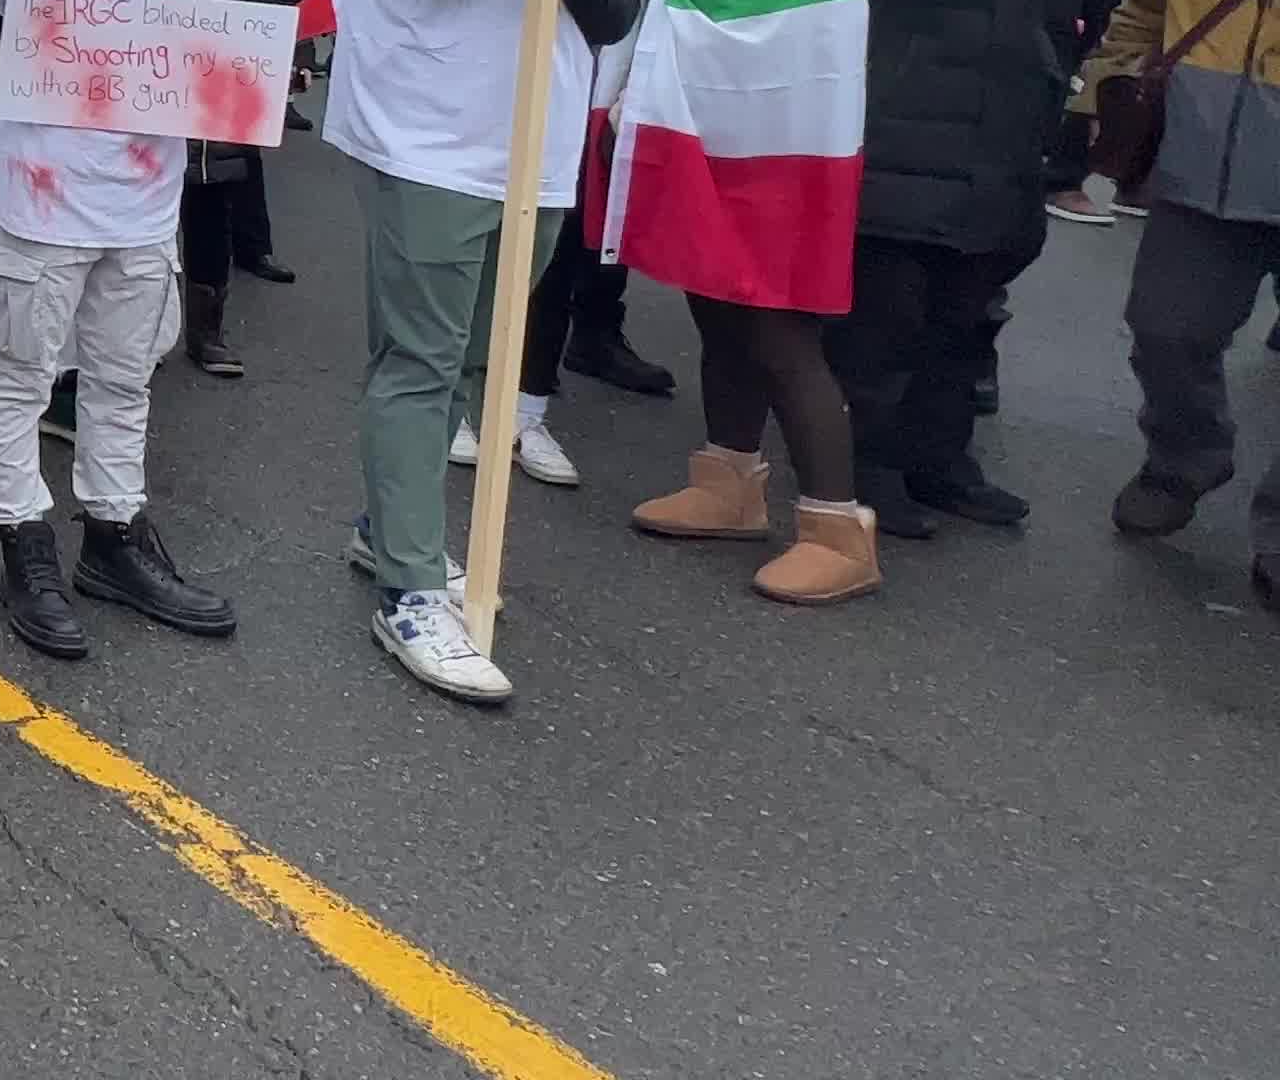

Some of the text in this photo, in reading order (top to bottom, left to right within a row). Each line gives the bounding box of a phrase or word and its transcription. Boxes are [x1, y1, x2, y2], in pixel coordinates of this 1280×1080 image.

[15, 28, 280, 88] by Shooting my eye
[88, 74, 126, 102] BB
